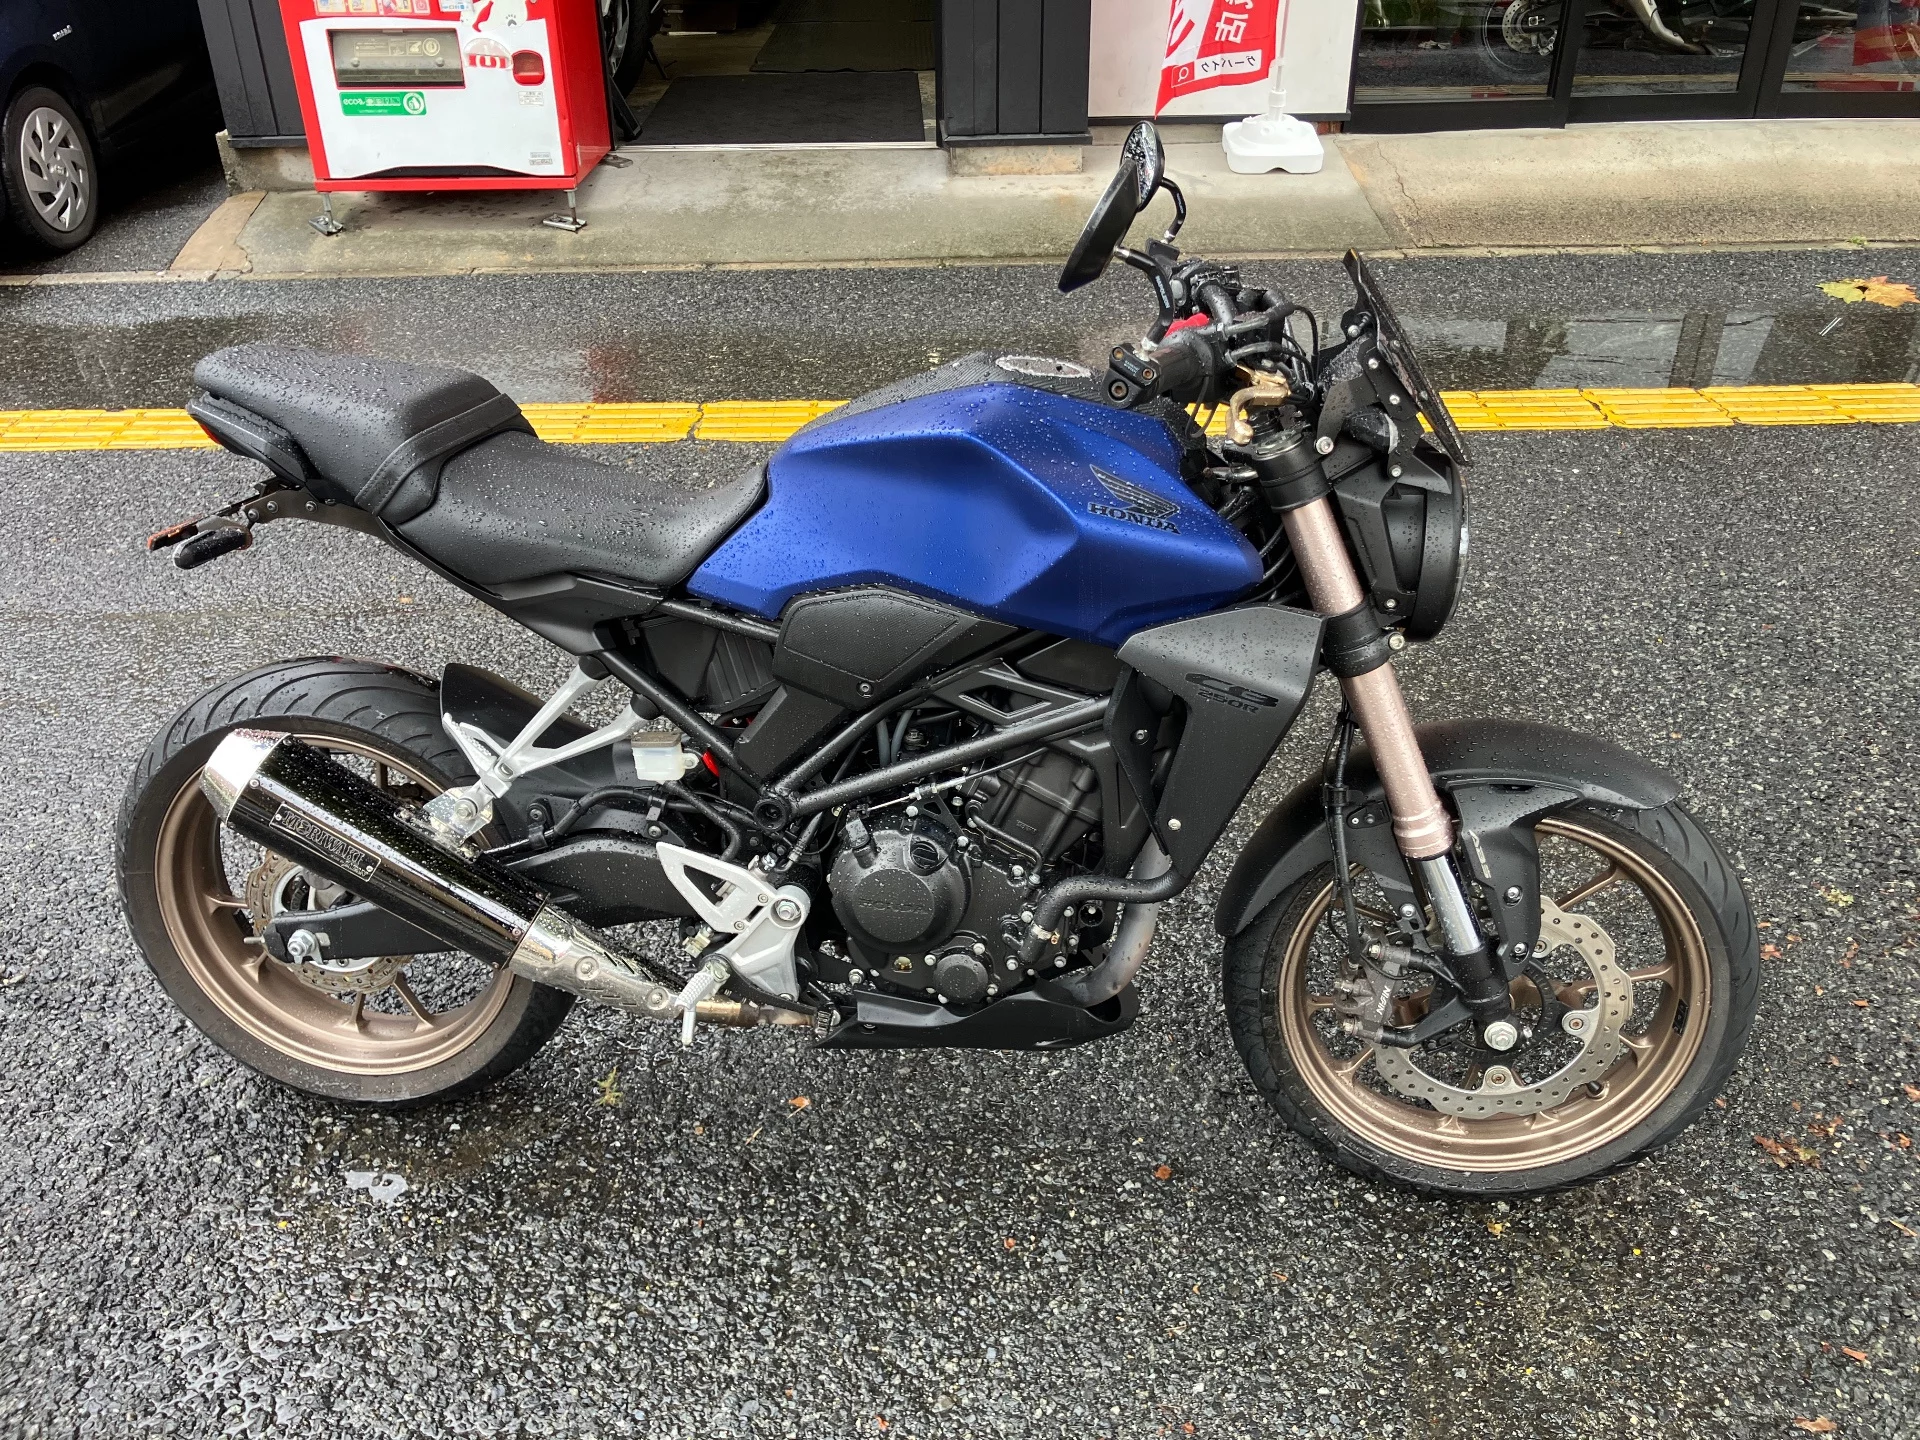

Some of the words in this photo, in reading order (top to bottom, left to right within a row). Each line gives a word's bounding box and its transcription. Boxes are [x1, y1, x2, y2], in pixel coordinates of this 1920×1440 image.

[1086, 501, 1181, 535] HONDA
[1184, 672, 1280, 708] CB
[1197, 687, 1260, 714] 250R
[282, 809, 366, 866] MORIWAKI
[1468, 829, 1492, 879] ABS
